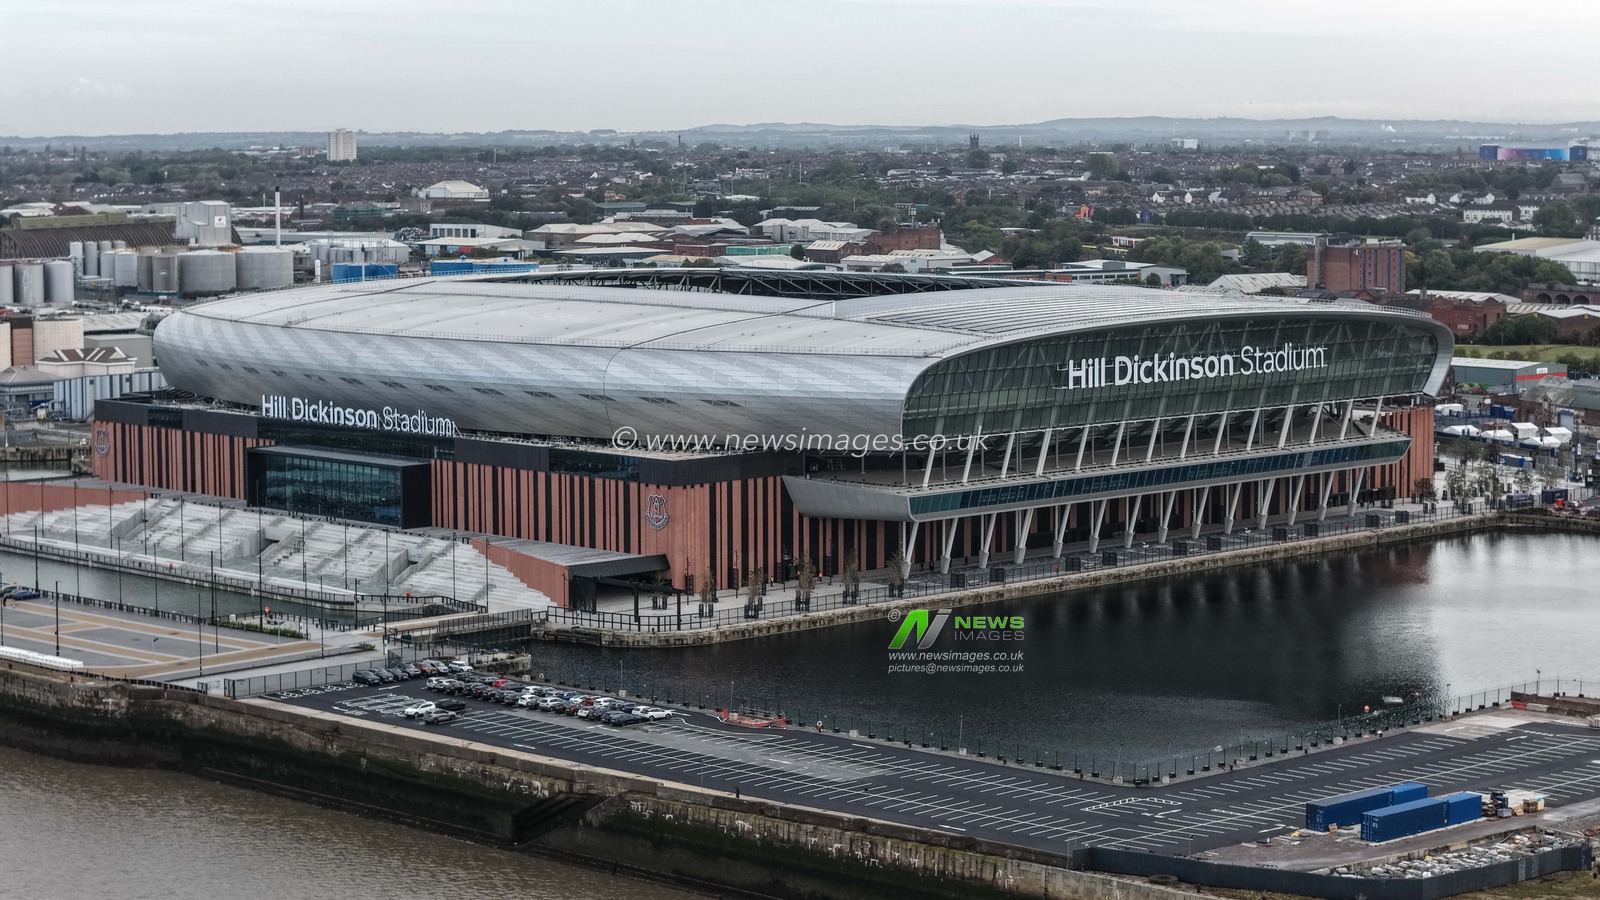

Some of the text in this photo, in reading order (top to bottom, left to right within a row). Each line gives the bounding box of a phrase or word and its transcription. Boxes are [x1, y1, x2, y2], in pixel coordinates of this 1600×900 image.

[1069, 343, 1324, 389] Hill Dickinson Stadium
[262, 395, 452, 435] Hill Dickinson Stadium
